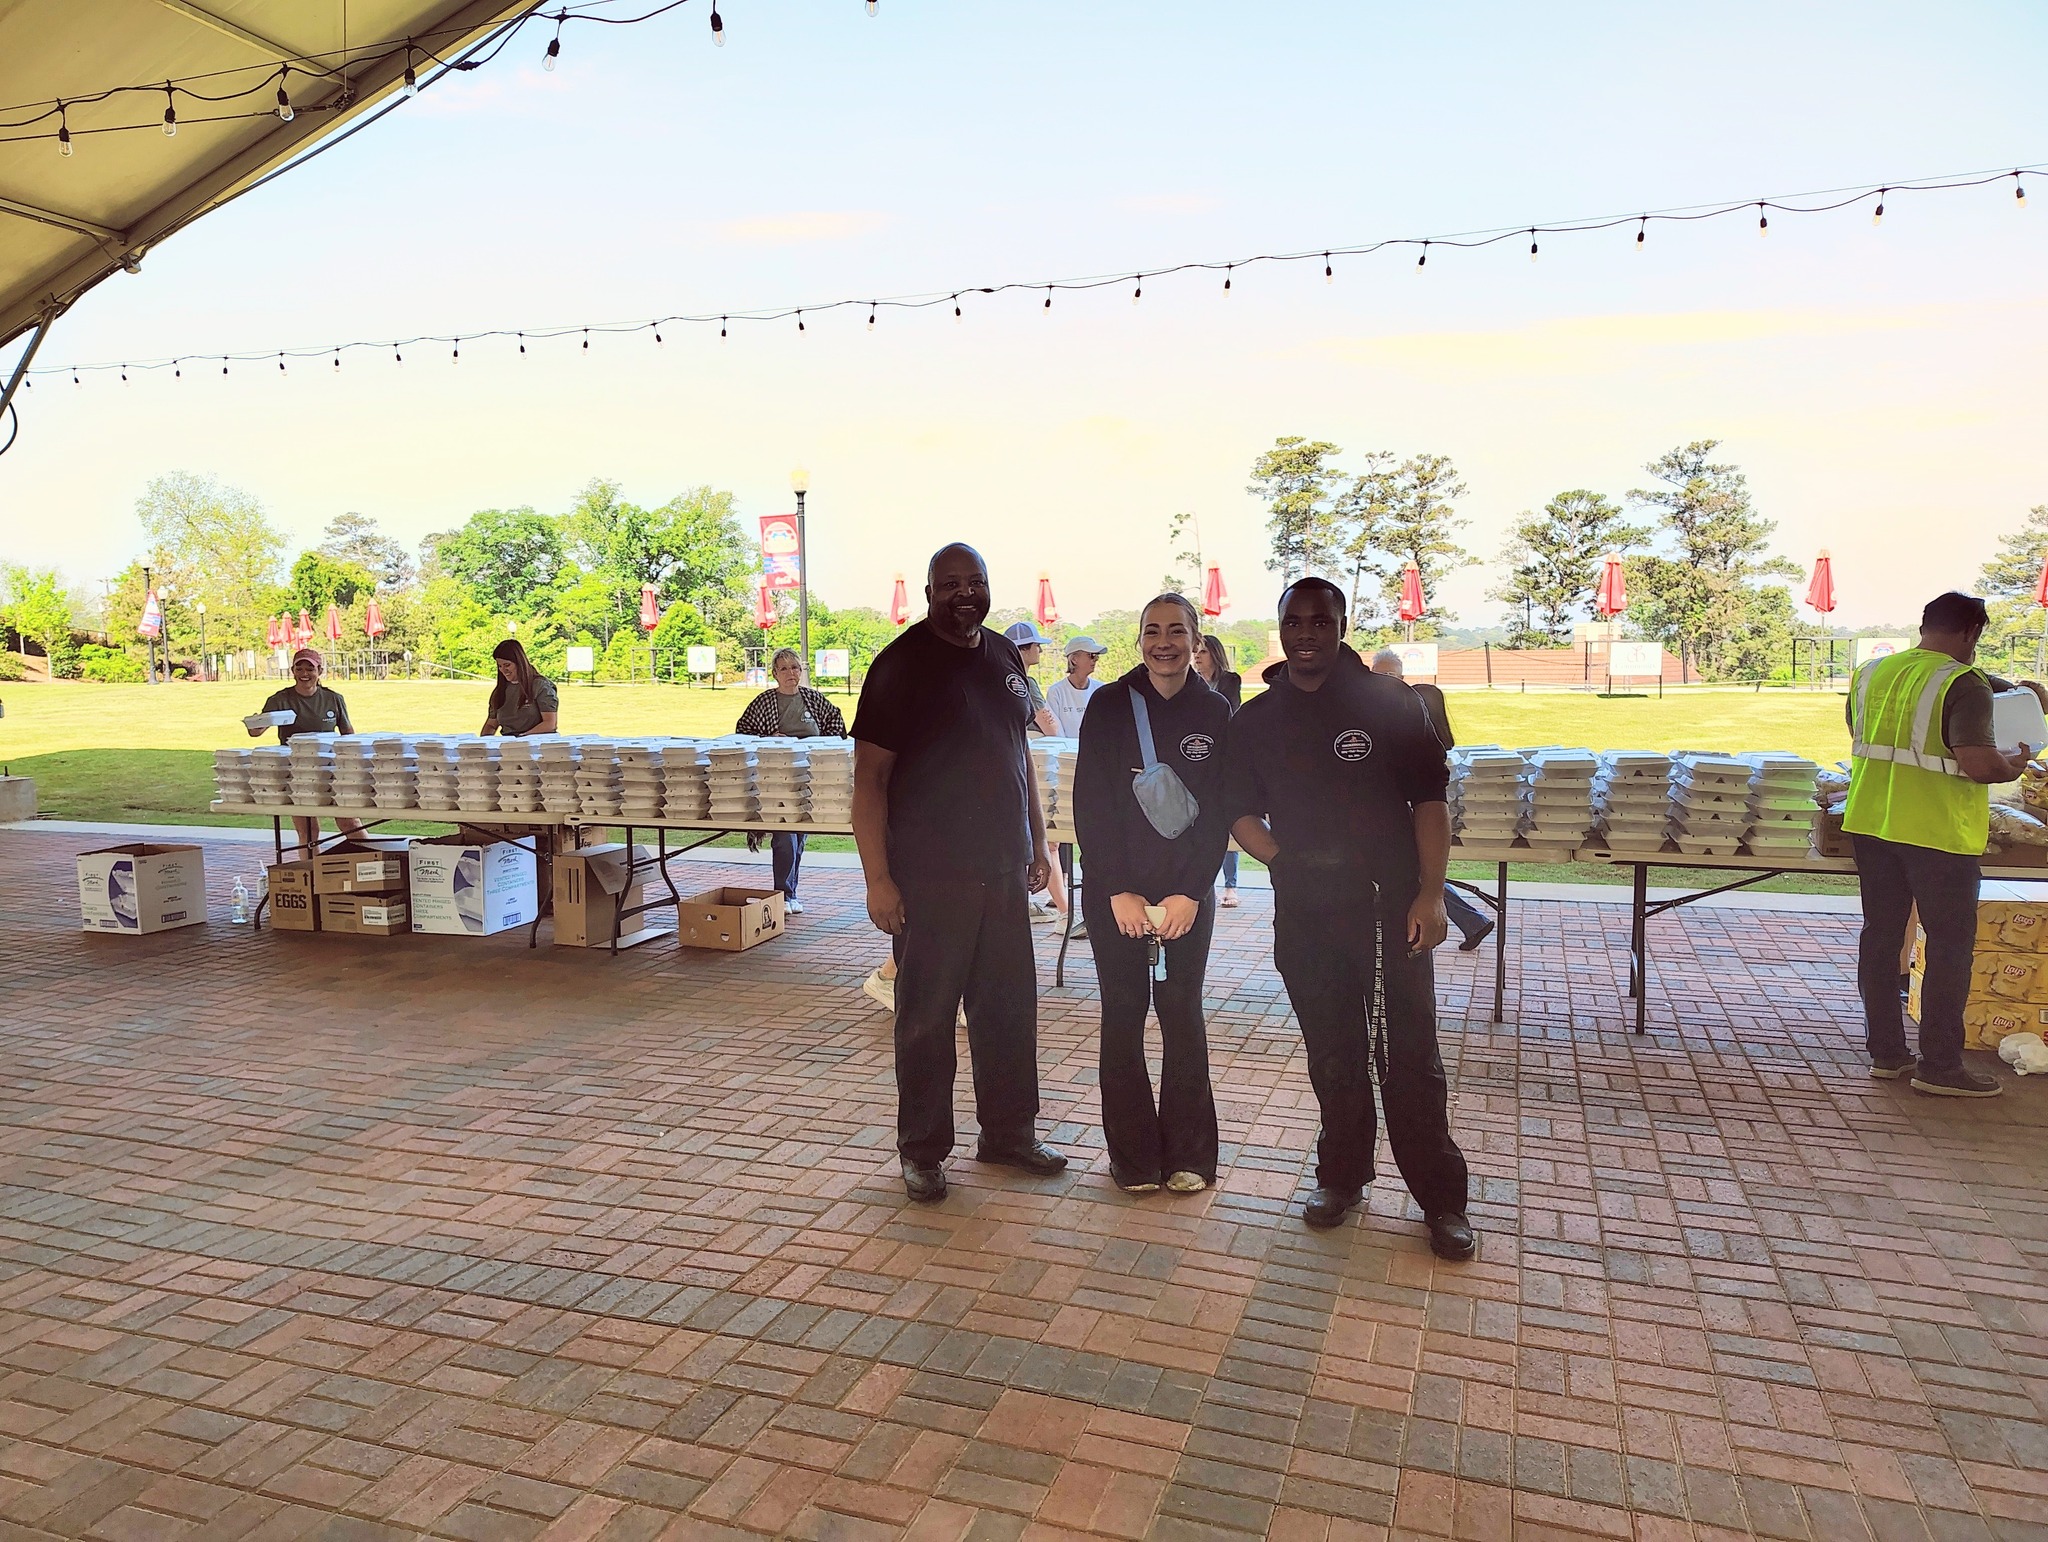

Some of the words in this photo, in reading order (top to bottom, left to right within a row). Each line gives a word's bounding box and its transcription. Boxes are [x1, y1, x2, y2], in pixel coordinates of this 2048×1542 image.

[502, 847, 518, 856] FIRST
[419, 868, 440, 876] Mark
[275, 892, 307, 909] EGGS
